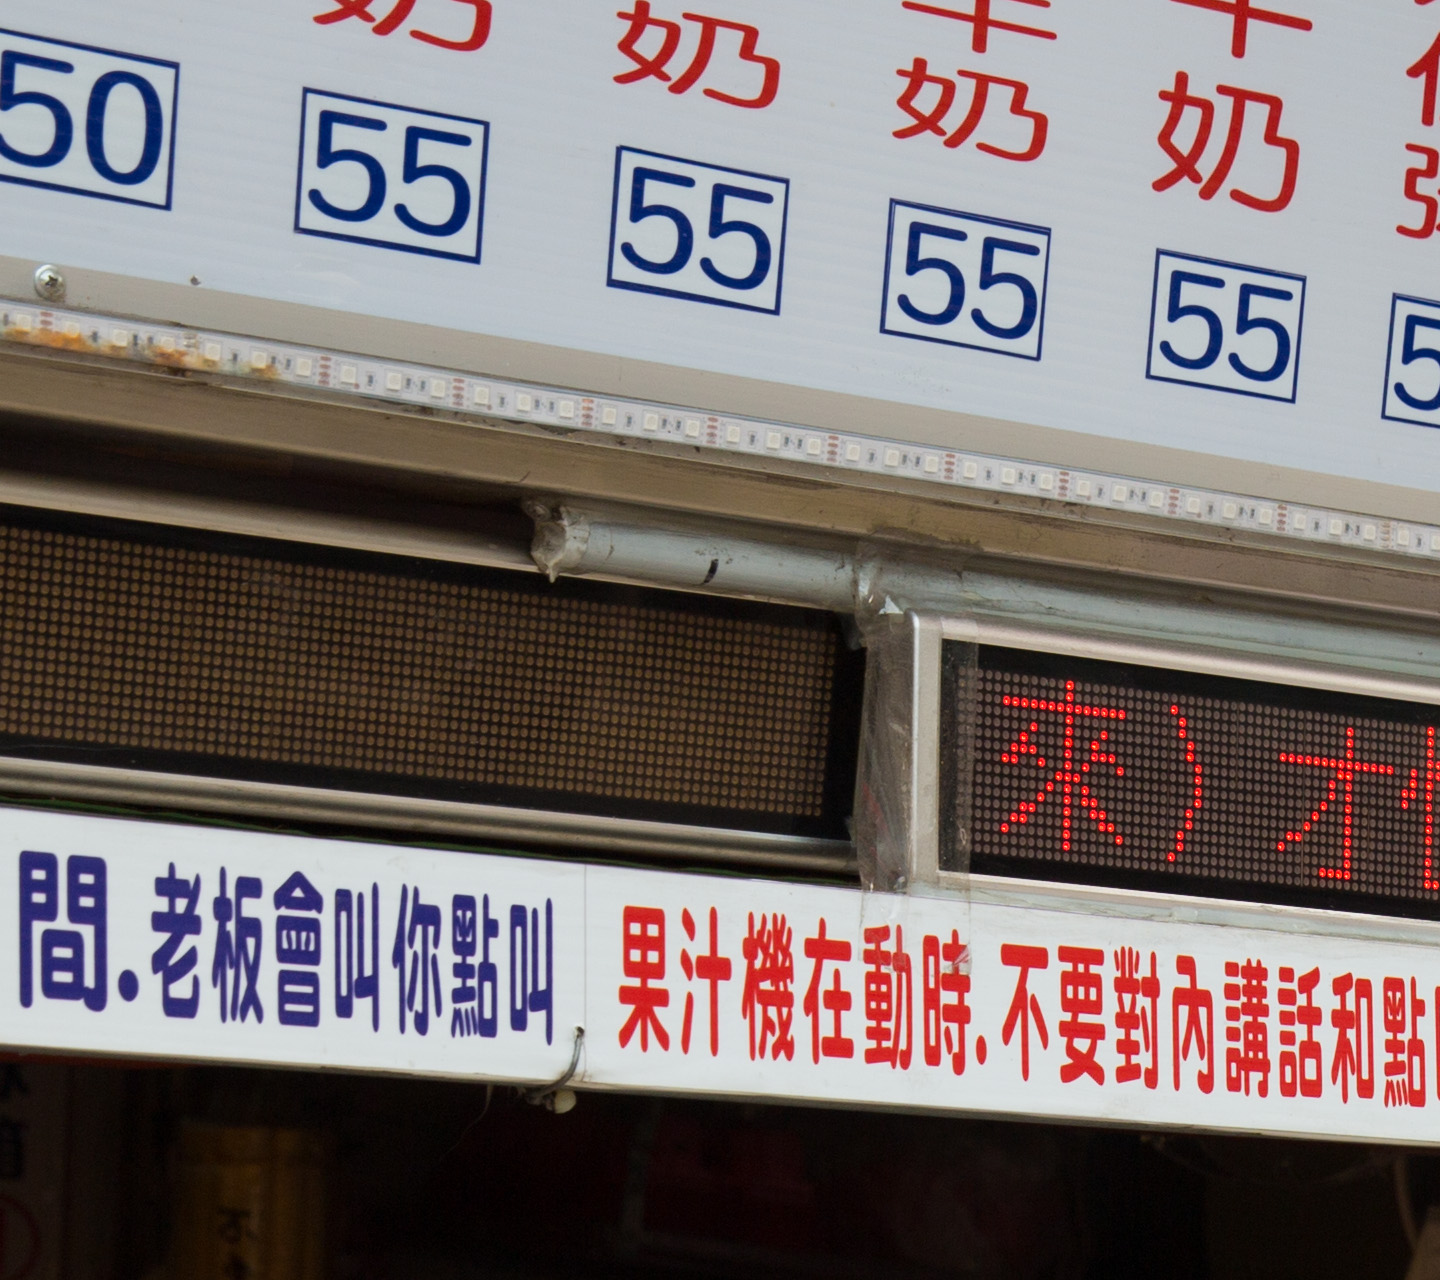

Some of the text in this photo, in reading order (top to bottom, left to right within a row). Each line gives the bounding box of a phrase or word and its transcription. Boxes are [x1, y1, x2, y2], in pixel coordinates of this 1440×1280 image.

[307, 108, 472, 238] 55
[620, 166, 774, 291] 55
[896, 220, 1042, 340] 55
[1159, 270, 1295, 383] 55
